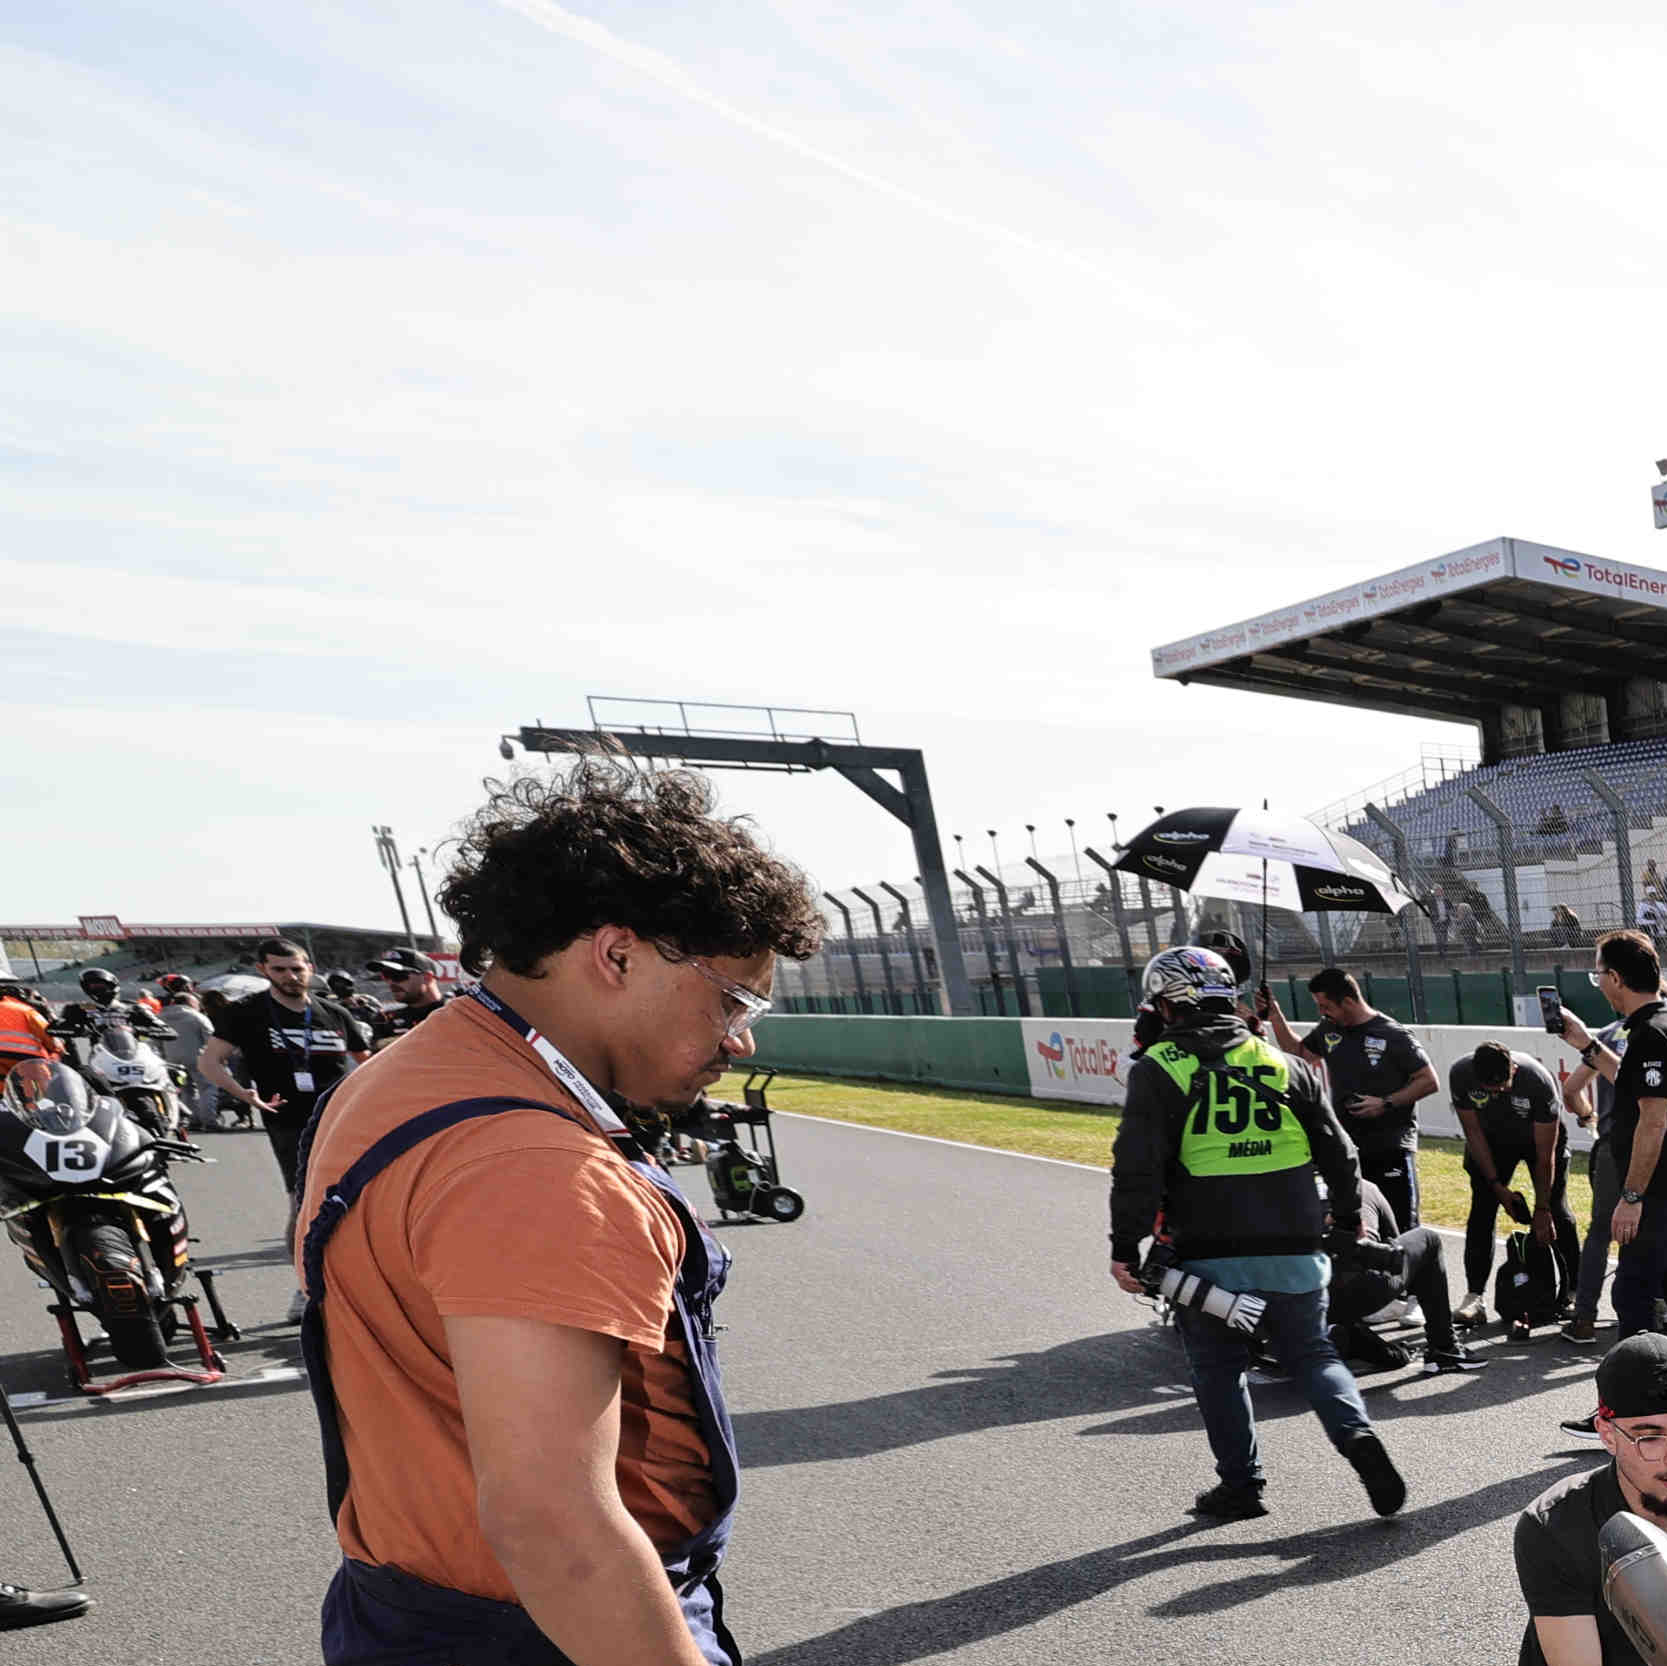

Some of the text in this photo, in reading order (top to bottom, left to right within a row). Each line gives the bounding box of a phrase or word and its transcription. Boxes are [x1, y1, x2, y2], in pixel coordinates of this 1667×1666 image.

[1160, 831, 1210, 843] alpha
[1318, 885, 1365, 897] alpha
[118, 1066, 144, 1076] 95
[1191, 1065, 1283, 1135] 155
[45, 1140, 98, 1172] 13
[1228, 1139, 1273, 1158] MÉDIA
